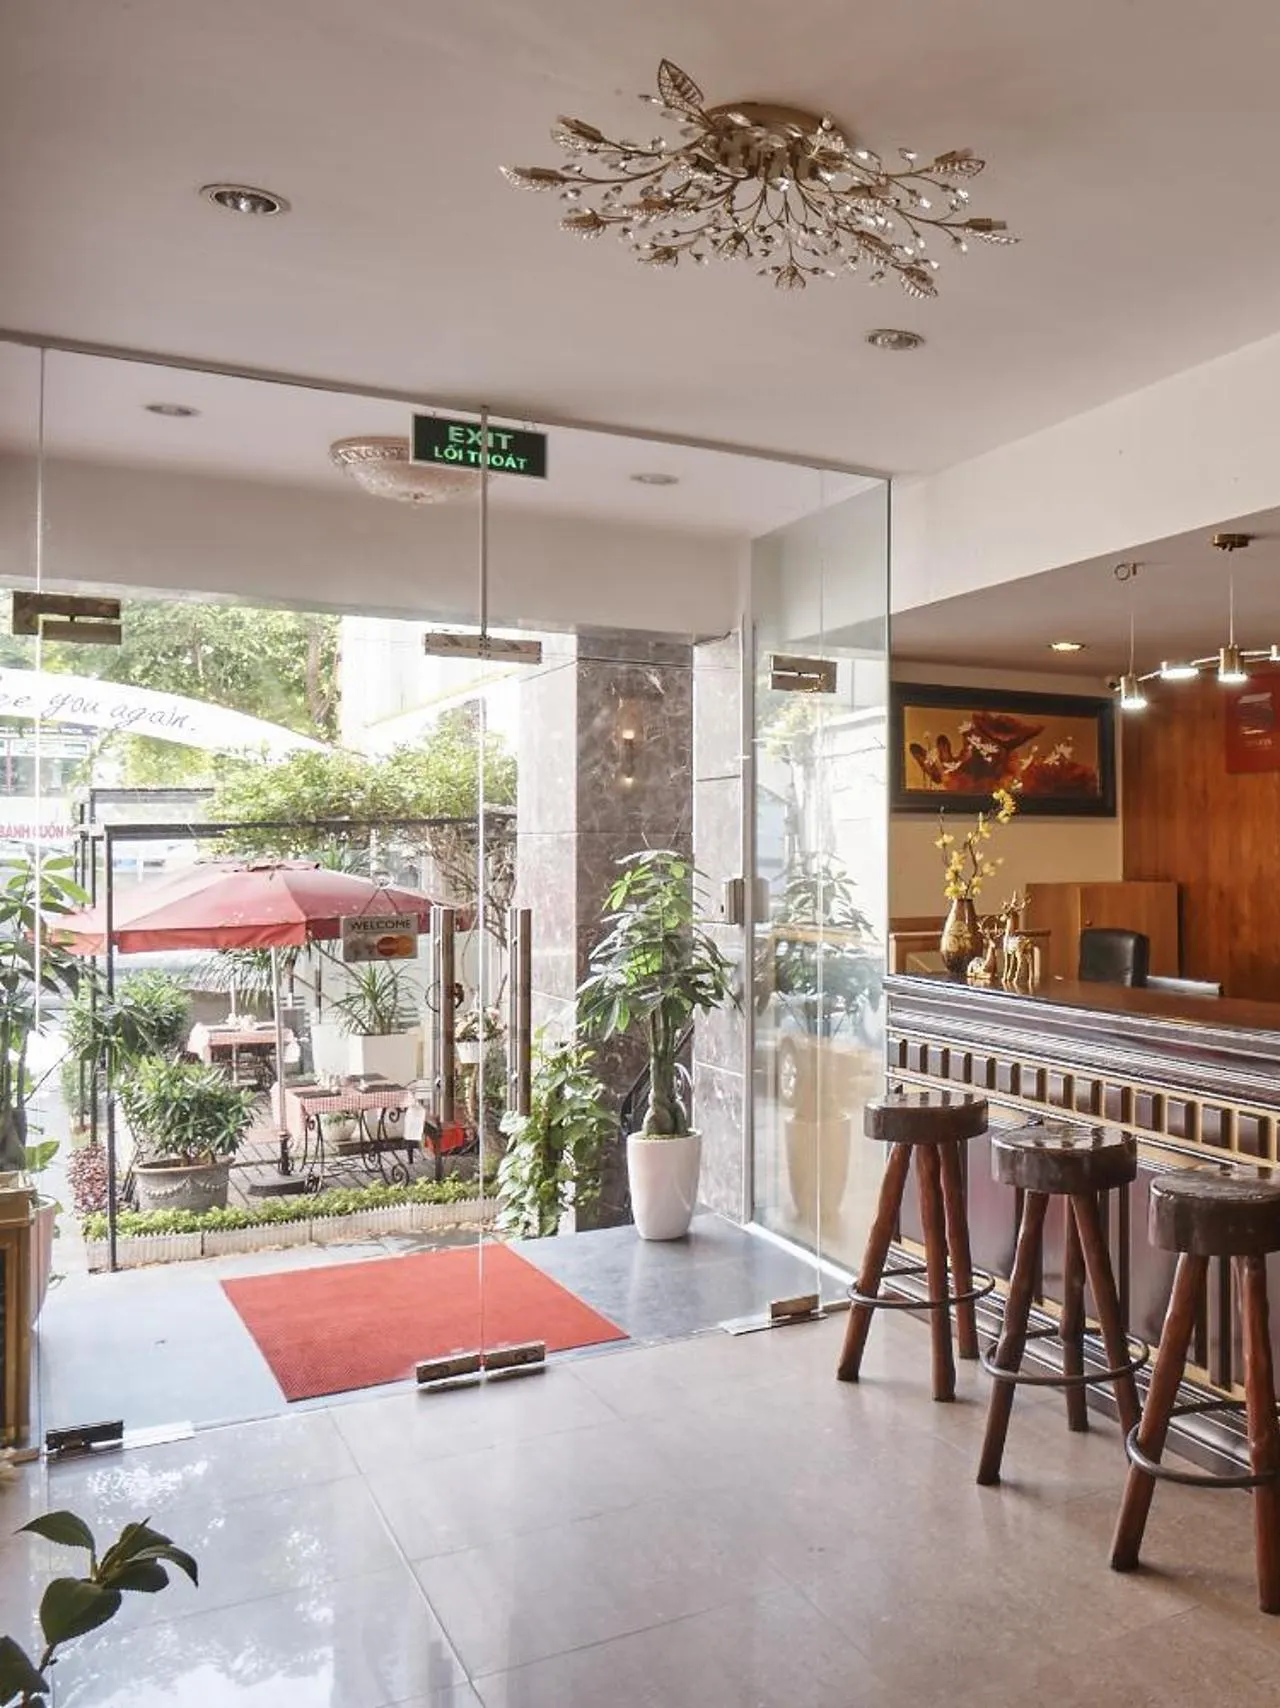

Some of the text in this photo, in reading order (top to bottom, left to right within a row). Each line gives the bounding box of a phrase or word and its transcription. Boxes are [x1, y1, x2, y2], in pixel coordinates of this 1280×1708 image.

[448, 425, 514, 450] EXIT
[41, 694, 100, 722] you
[351, 919, 412, 931] WELCOME
